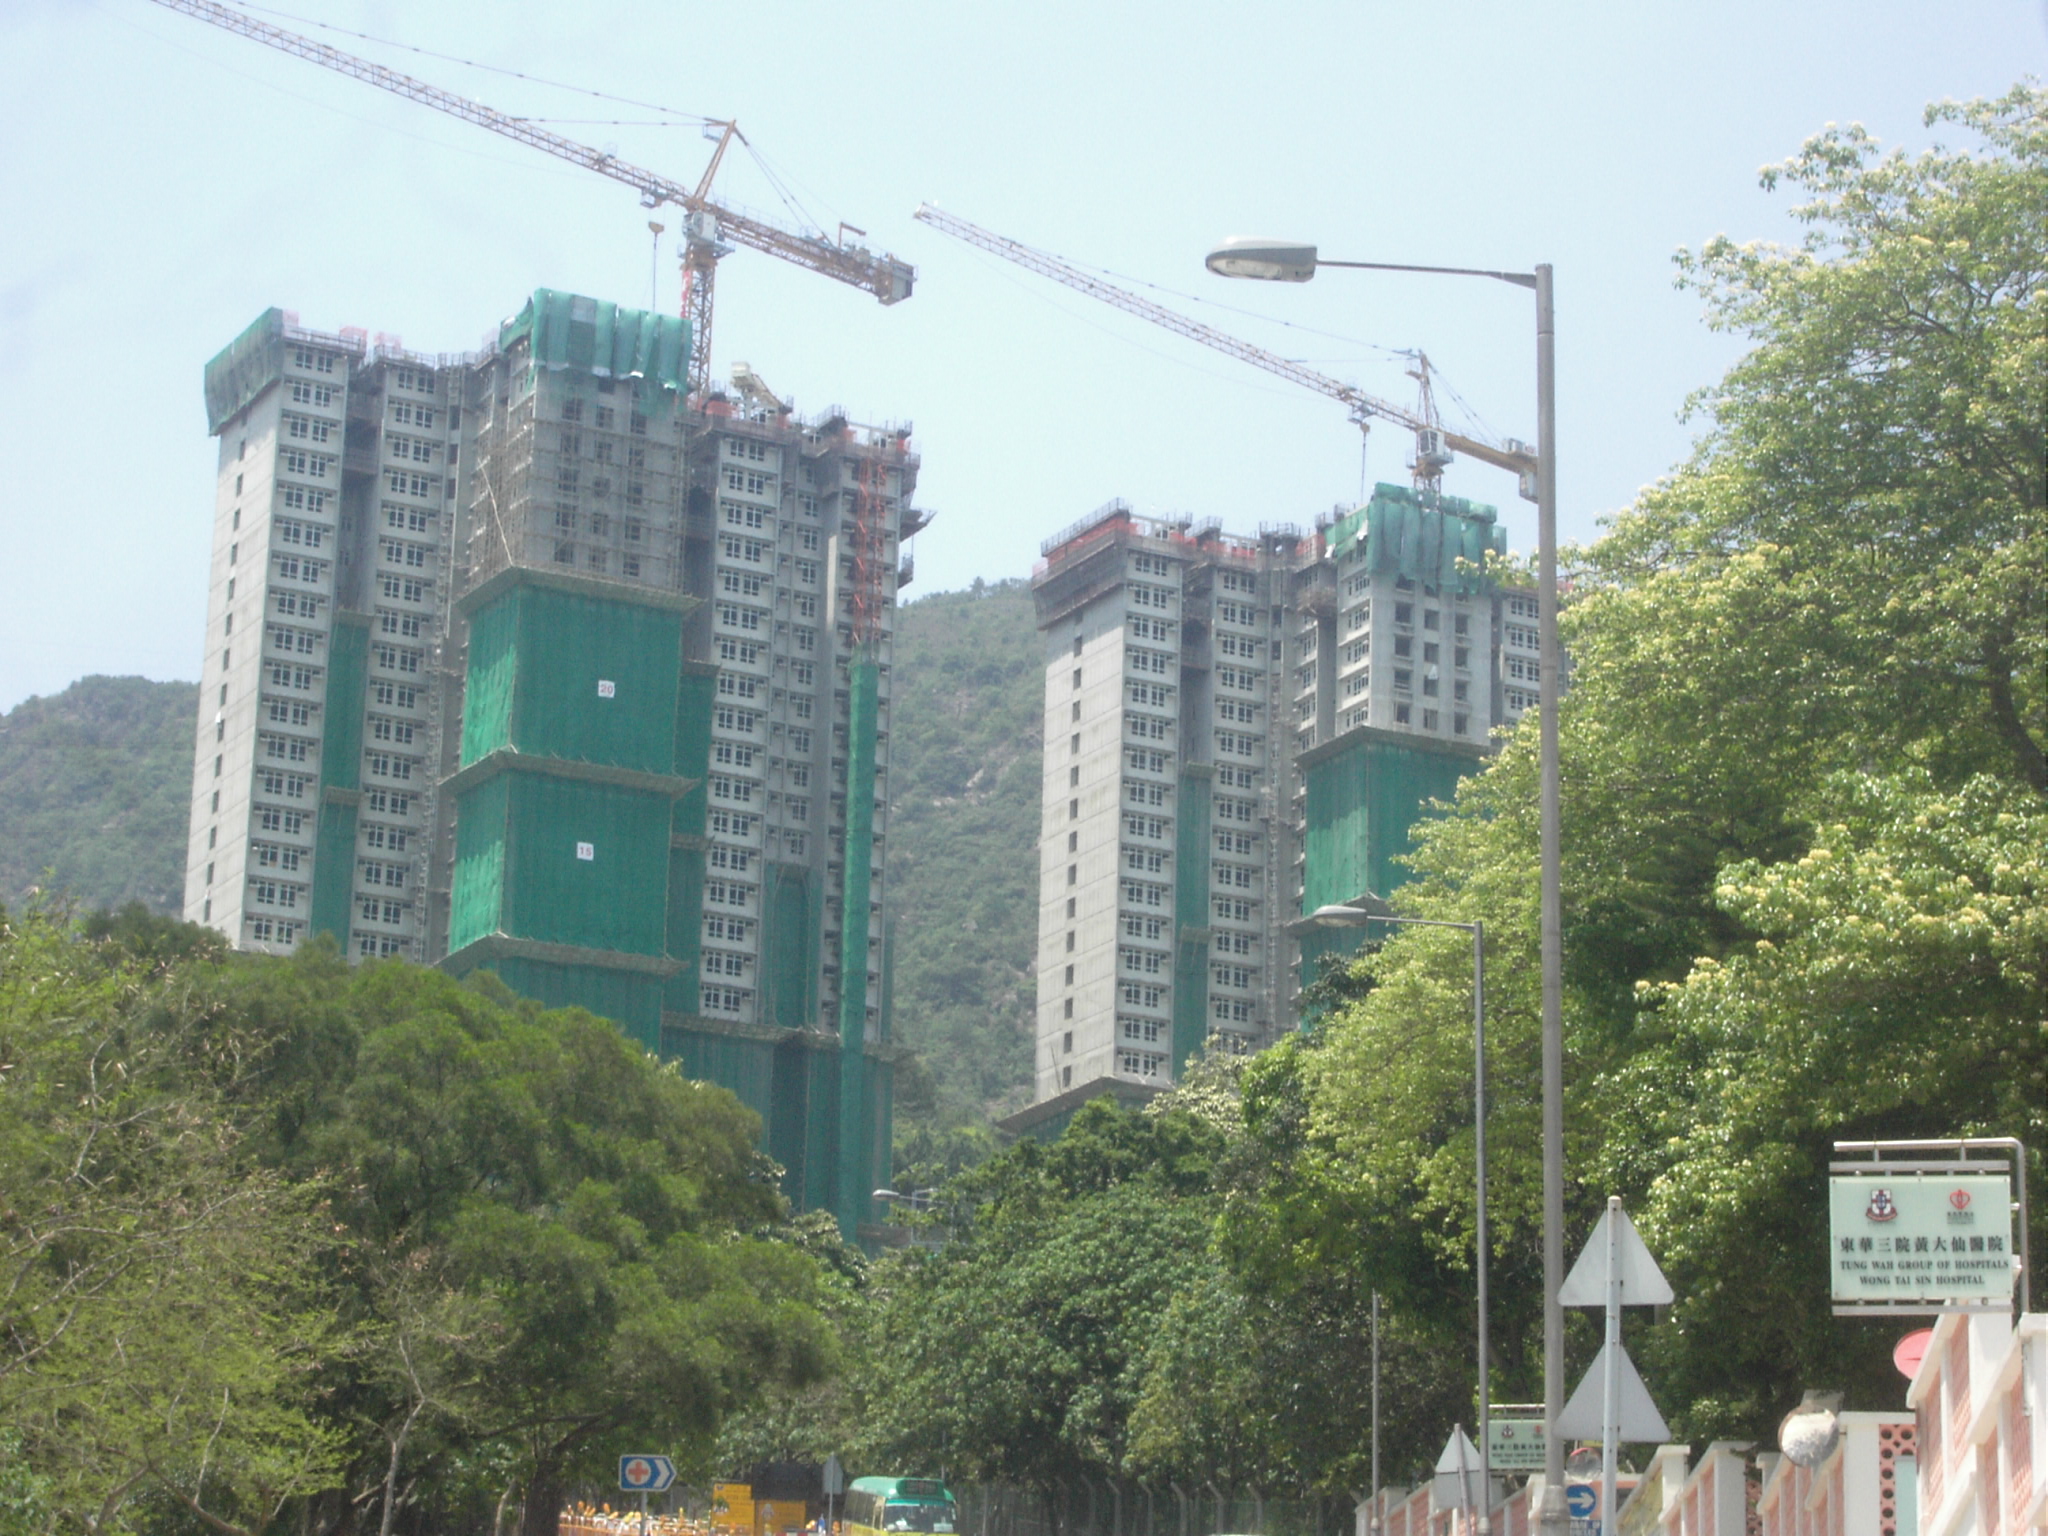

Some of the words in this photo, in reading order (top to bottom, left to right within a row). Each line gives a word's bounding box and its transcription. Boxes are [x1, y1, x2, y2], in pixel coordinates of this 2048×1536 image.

[599, 683, 614, 695] 20
[579, 846, 592, 857] 15
[1840, 1235, 2004, 1253] 東華三院黃大仙醫院
[1840, 1260, 1867, 1270] TUNG
[1871, 1260, 1894, 1270] WAH
[1898, 1260, 1933, 1270] GROUP
[1937, 1260, 1951, 1270] OF
[1955, 1259, 2009, 1269] HOSPITALS
[1859, 1275, 1891, 1285] WONG
[1895, 1275, 1911, 1285] TAI
[1915, 1275, 1931, 1285] SIN
[1936, 1274, 1985, 1285] HOSPITAL
